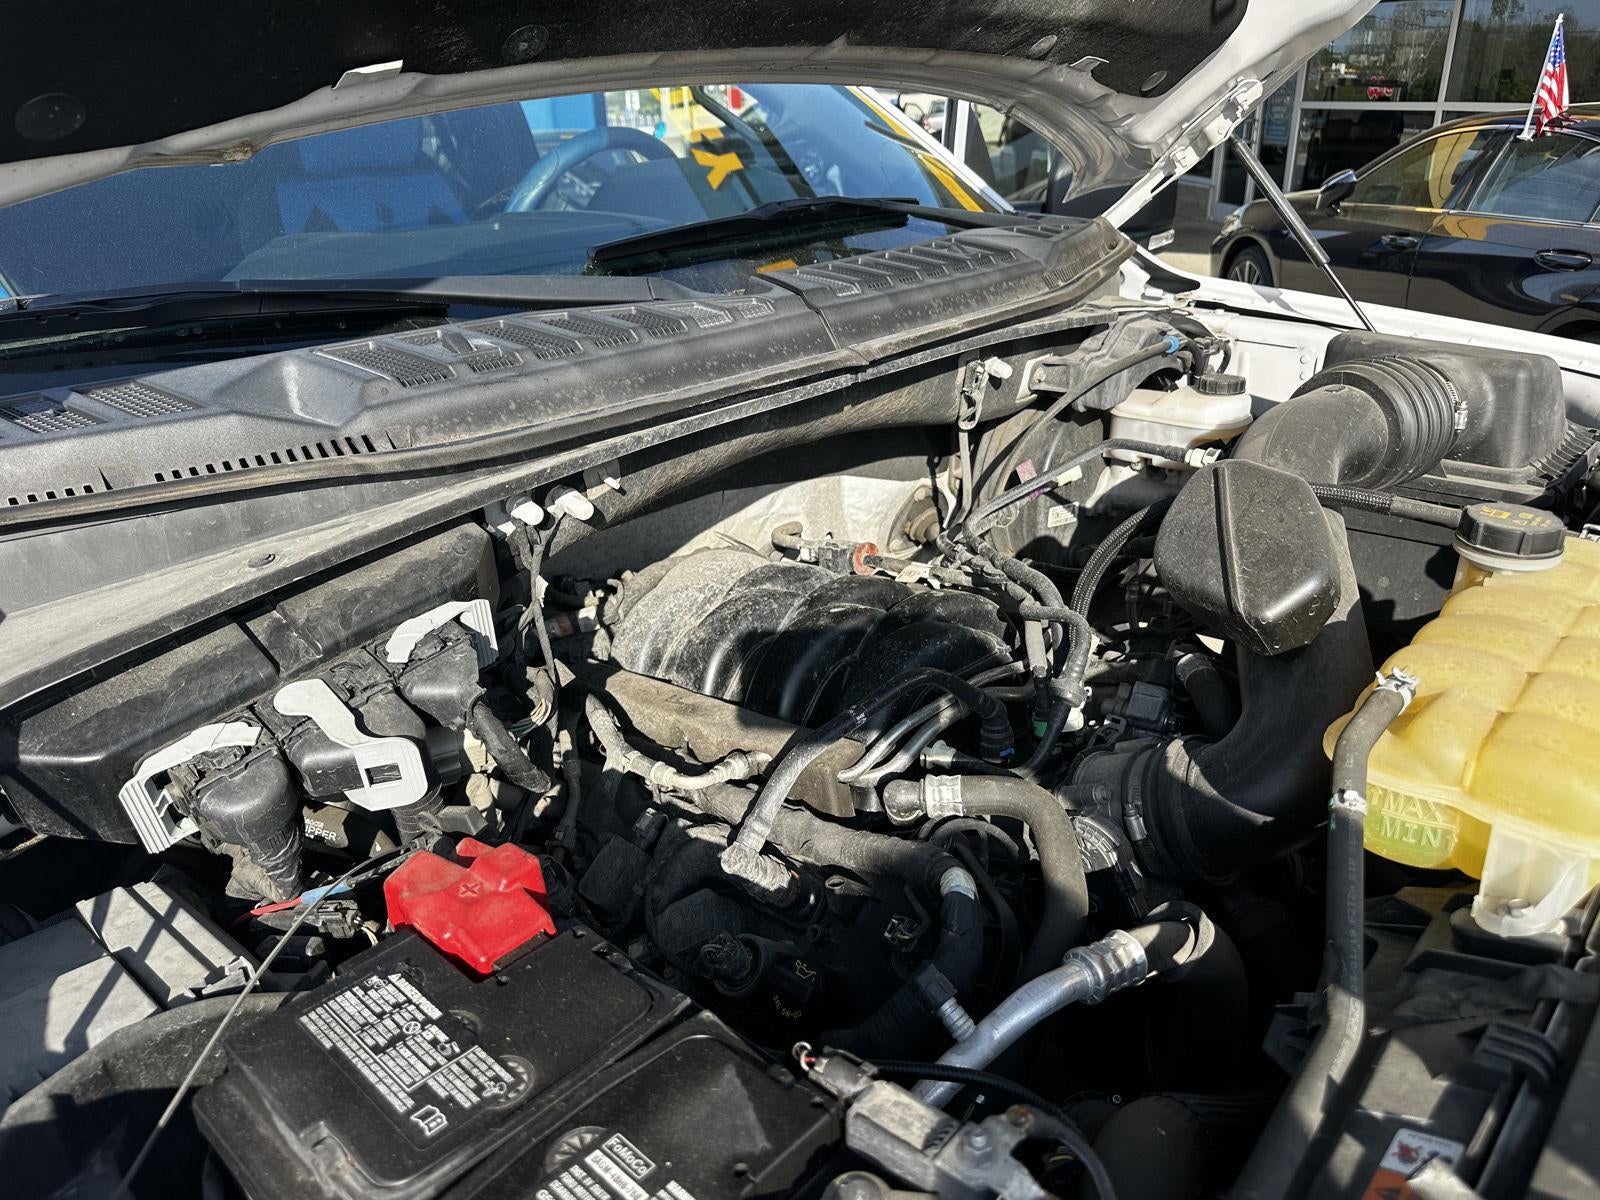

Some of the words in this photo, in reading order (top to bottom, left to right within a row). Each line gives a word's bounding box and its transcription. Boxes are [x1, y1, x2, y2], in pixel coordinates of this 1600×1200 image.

[1383, 790, 1443, 824] MAX
[1382, 815, 1441, 848] MIN
[606, 1137, 648, 1174] FoMoCo
